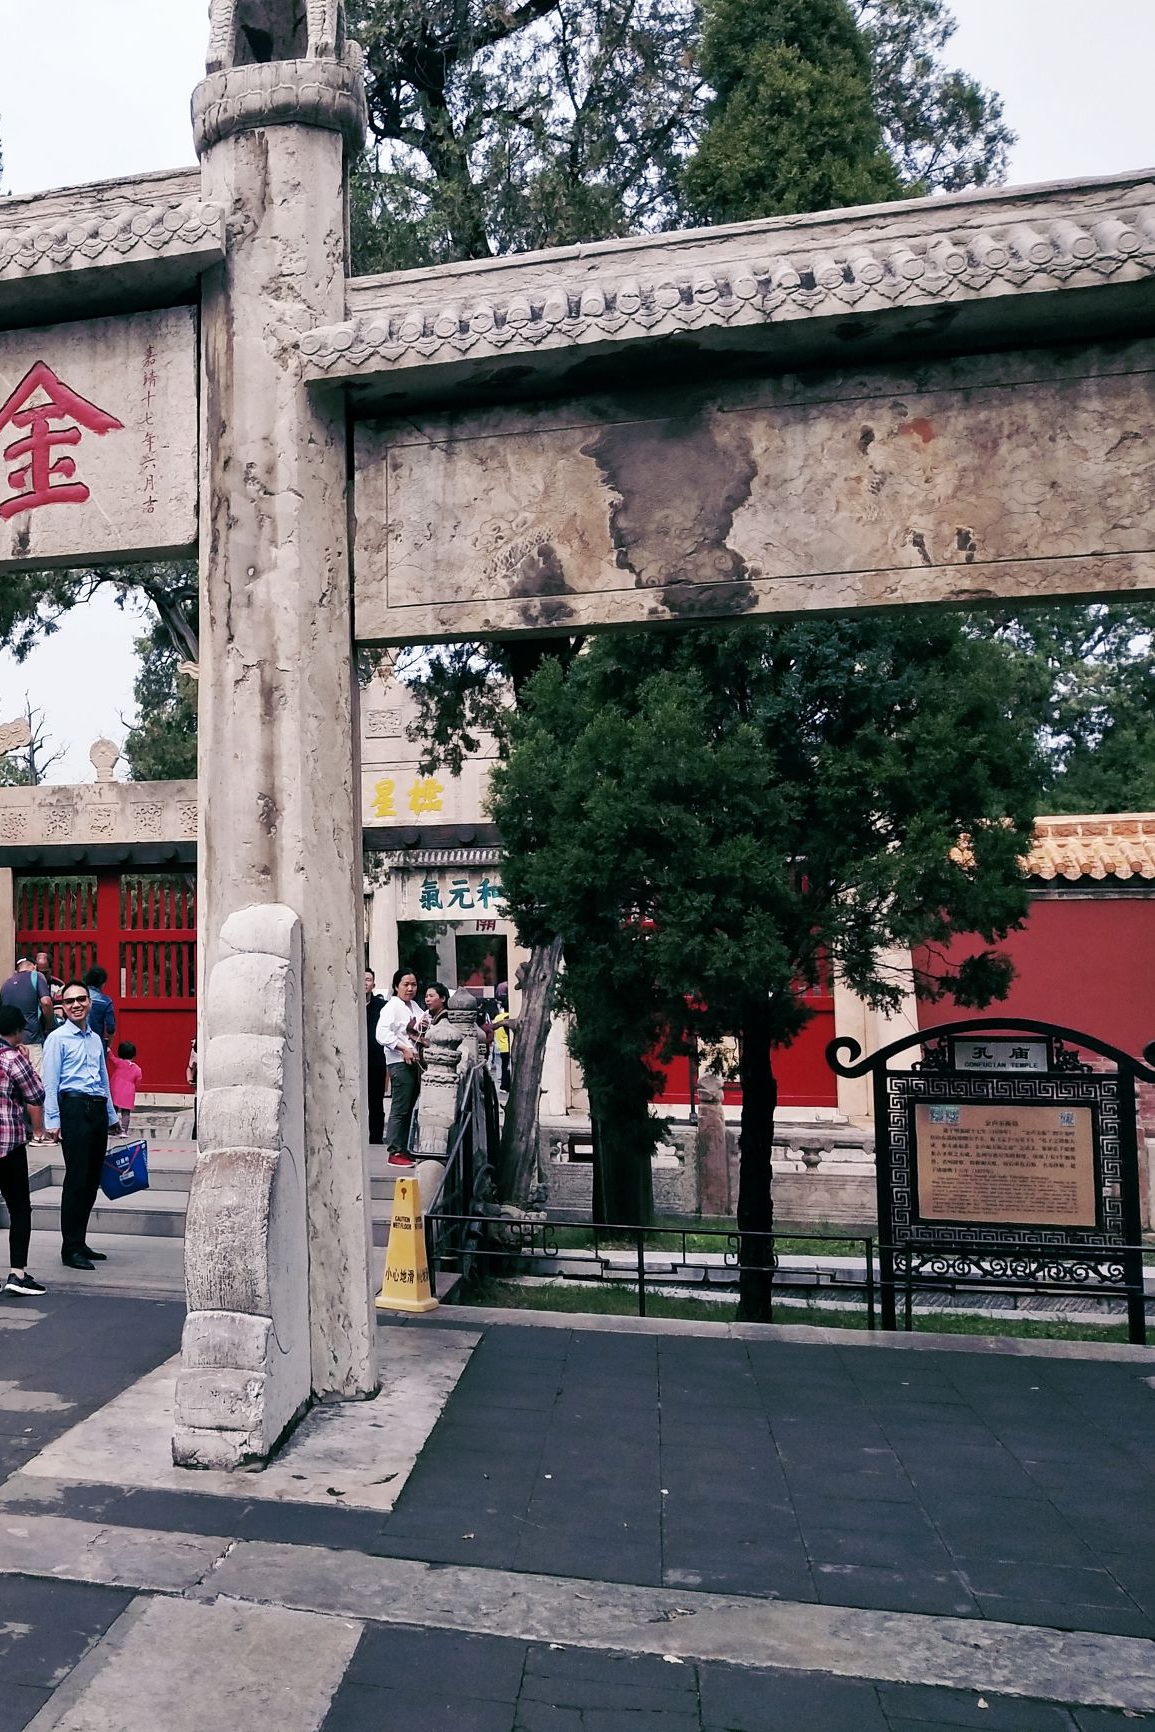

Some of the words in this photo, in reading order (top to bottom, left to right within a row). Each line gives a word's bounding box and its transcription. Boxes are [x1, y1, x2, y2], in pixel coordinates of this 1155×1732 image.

[972, 1047, 1030, 1060] 孔庙
[394, 1215, 411, 1223] CAUTION
[385, 1267, 415, 1283] 小心地滑
